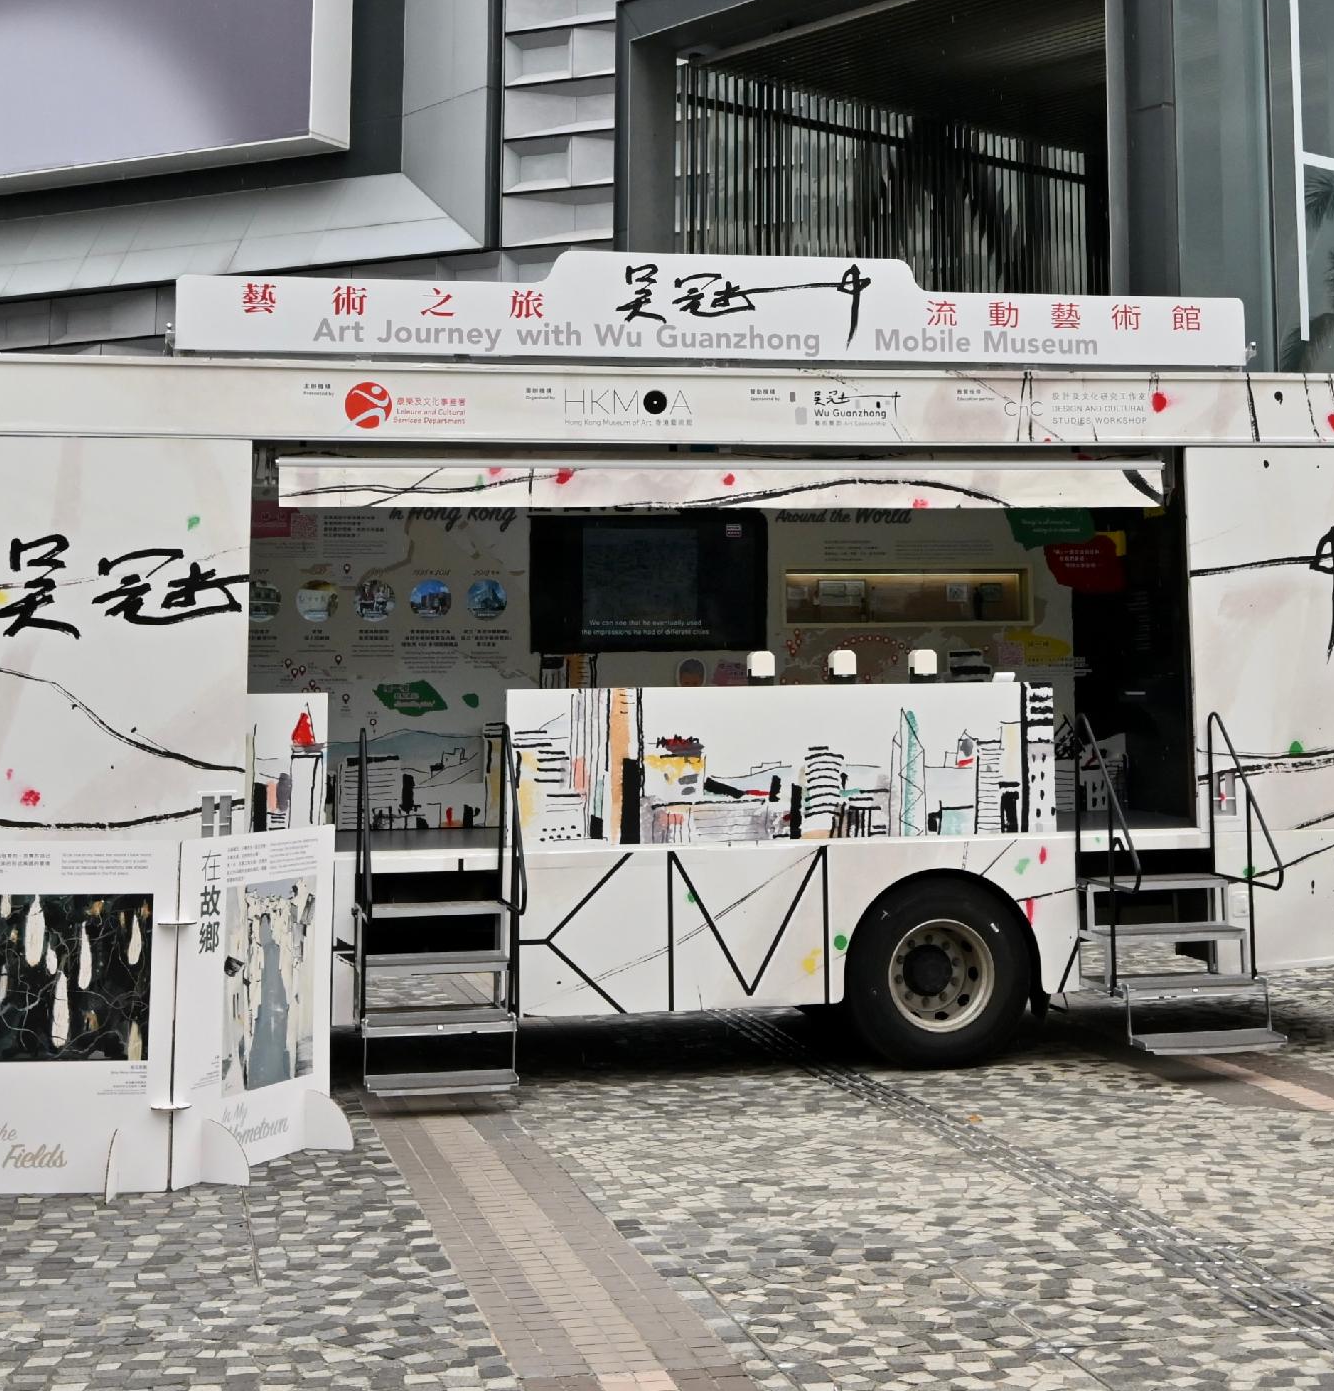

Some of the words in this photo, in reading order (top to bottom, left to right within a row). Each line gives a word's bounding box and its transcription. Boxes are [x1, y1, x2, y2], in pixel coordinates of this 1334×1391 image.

[242, 283, 544, 320] 藝術之旅
[926, 299, 1202, 332] 流動藝術館
[313, 318, 364, 343] Art
[377, 319, 501, 352] Journey
[517, 322, 582, 346] with
[596, 324, 642, 348] Wu
[656, 324, 820, 358] Guanzhong
[875, 328, 970, 354] Mobile
[983, 331, 1098, 356] Museum
[564, 389, 692, 415] HKMOA
[814, 409, 830, 417] Wu
[832, 409, 887, 419] Guanzhong
[1104, 404, 1145, 412] CULTURAL
[393, 416, 422, 424] Services
[424, 417, 466, 425] Department
[565, 419, 583, 427] Hong
[584, 419, 602, 427] Kong
[1052, 417, 1092, 425] STUDIES
[1095, 417, 1147, 425] WORKSHOP
[775, 509, 827, 523] Around
[829, 509, 851, 523] the
[855, 508, 912, 524] World
[198, 849, 223, 955] 在故鄉
[2, 1143, 68, 1169] Fields
